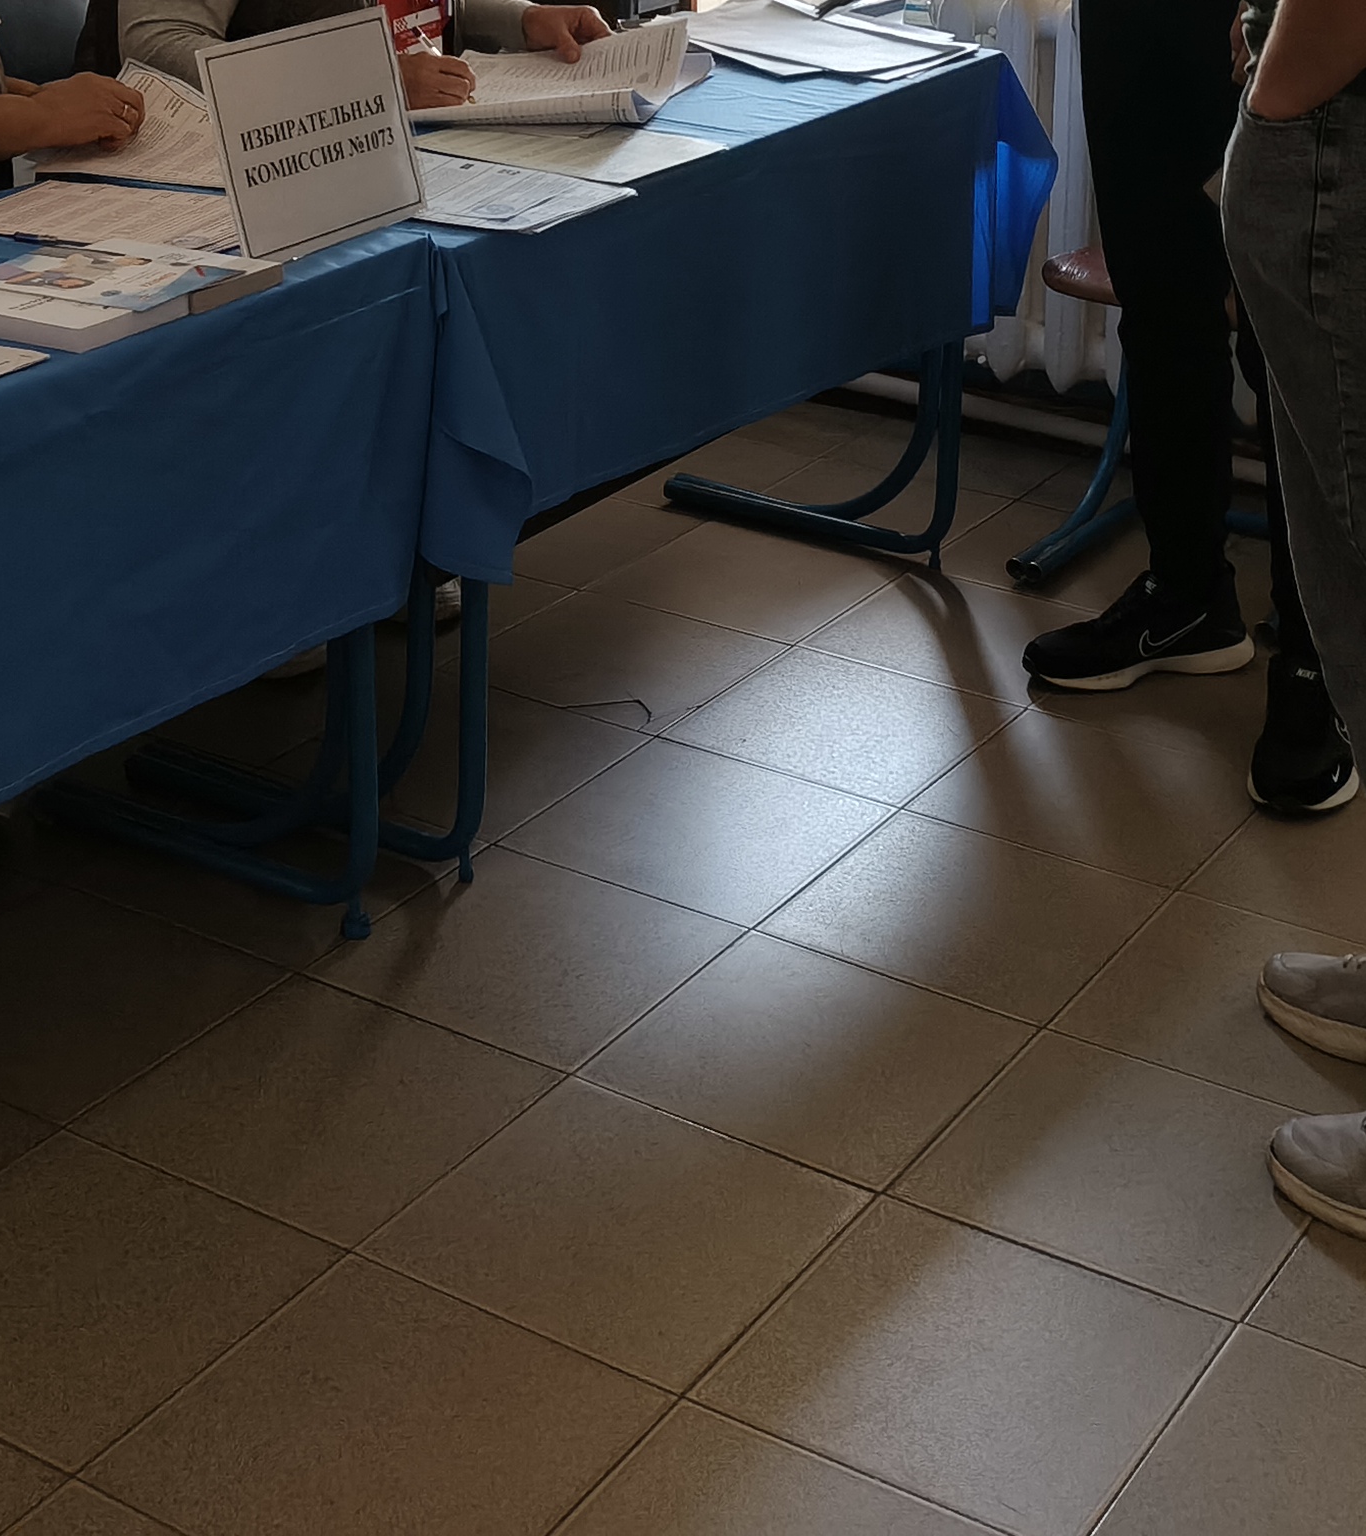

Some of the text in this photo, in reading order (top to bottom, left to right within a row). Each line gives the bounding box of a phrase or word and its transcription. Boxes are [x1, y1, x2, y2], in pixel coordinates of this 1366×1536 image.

[240, 94, 386, 152] ИЗБИРАТЕЛЬНАЯ
[244, 126, 395, 188] КОМИССИЯ №1073
